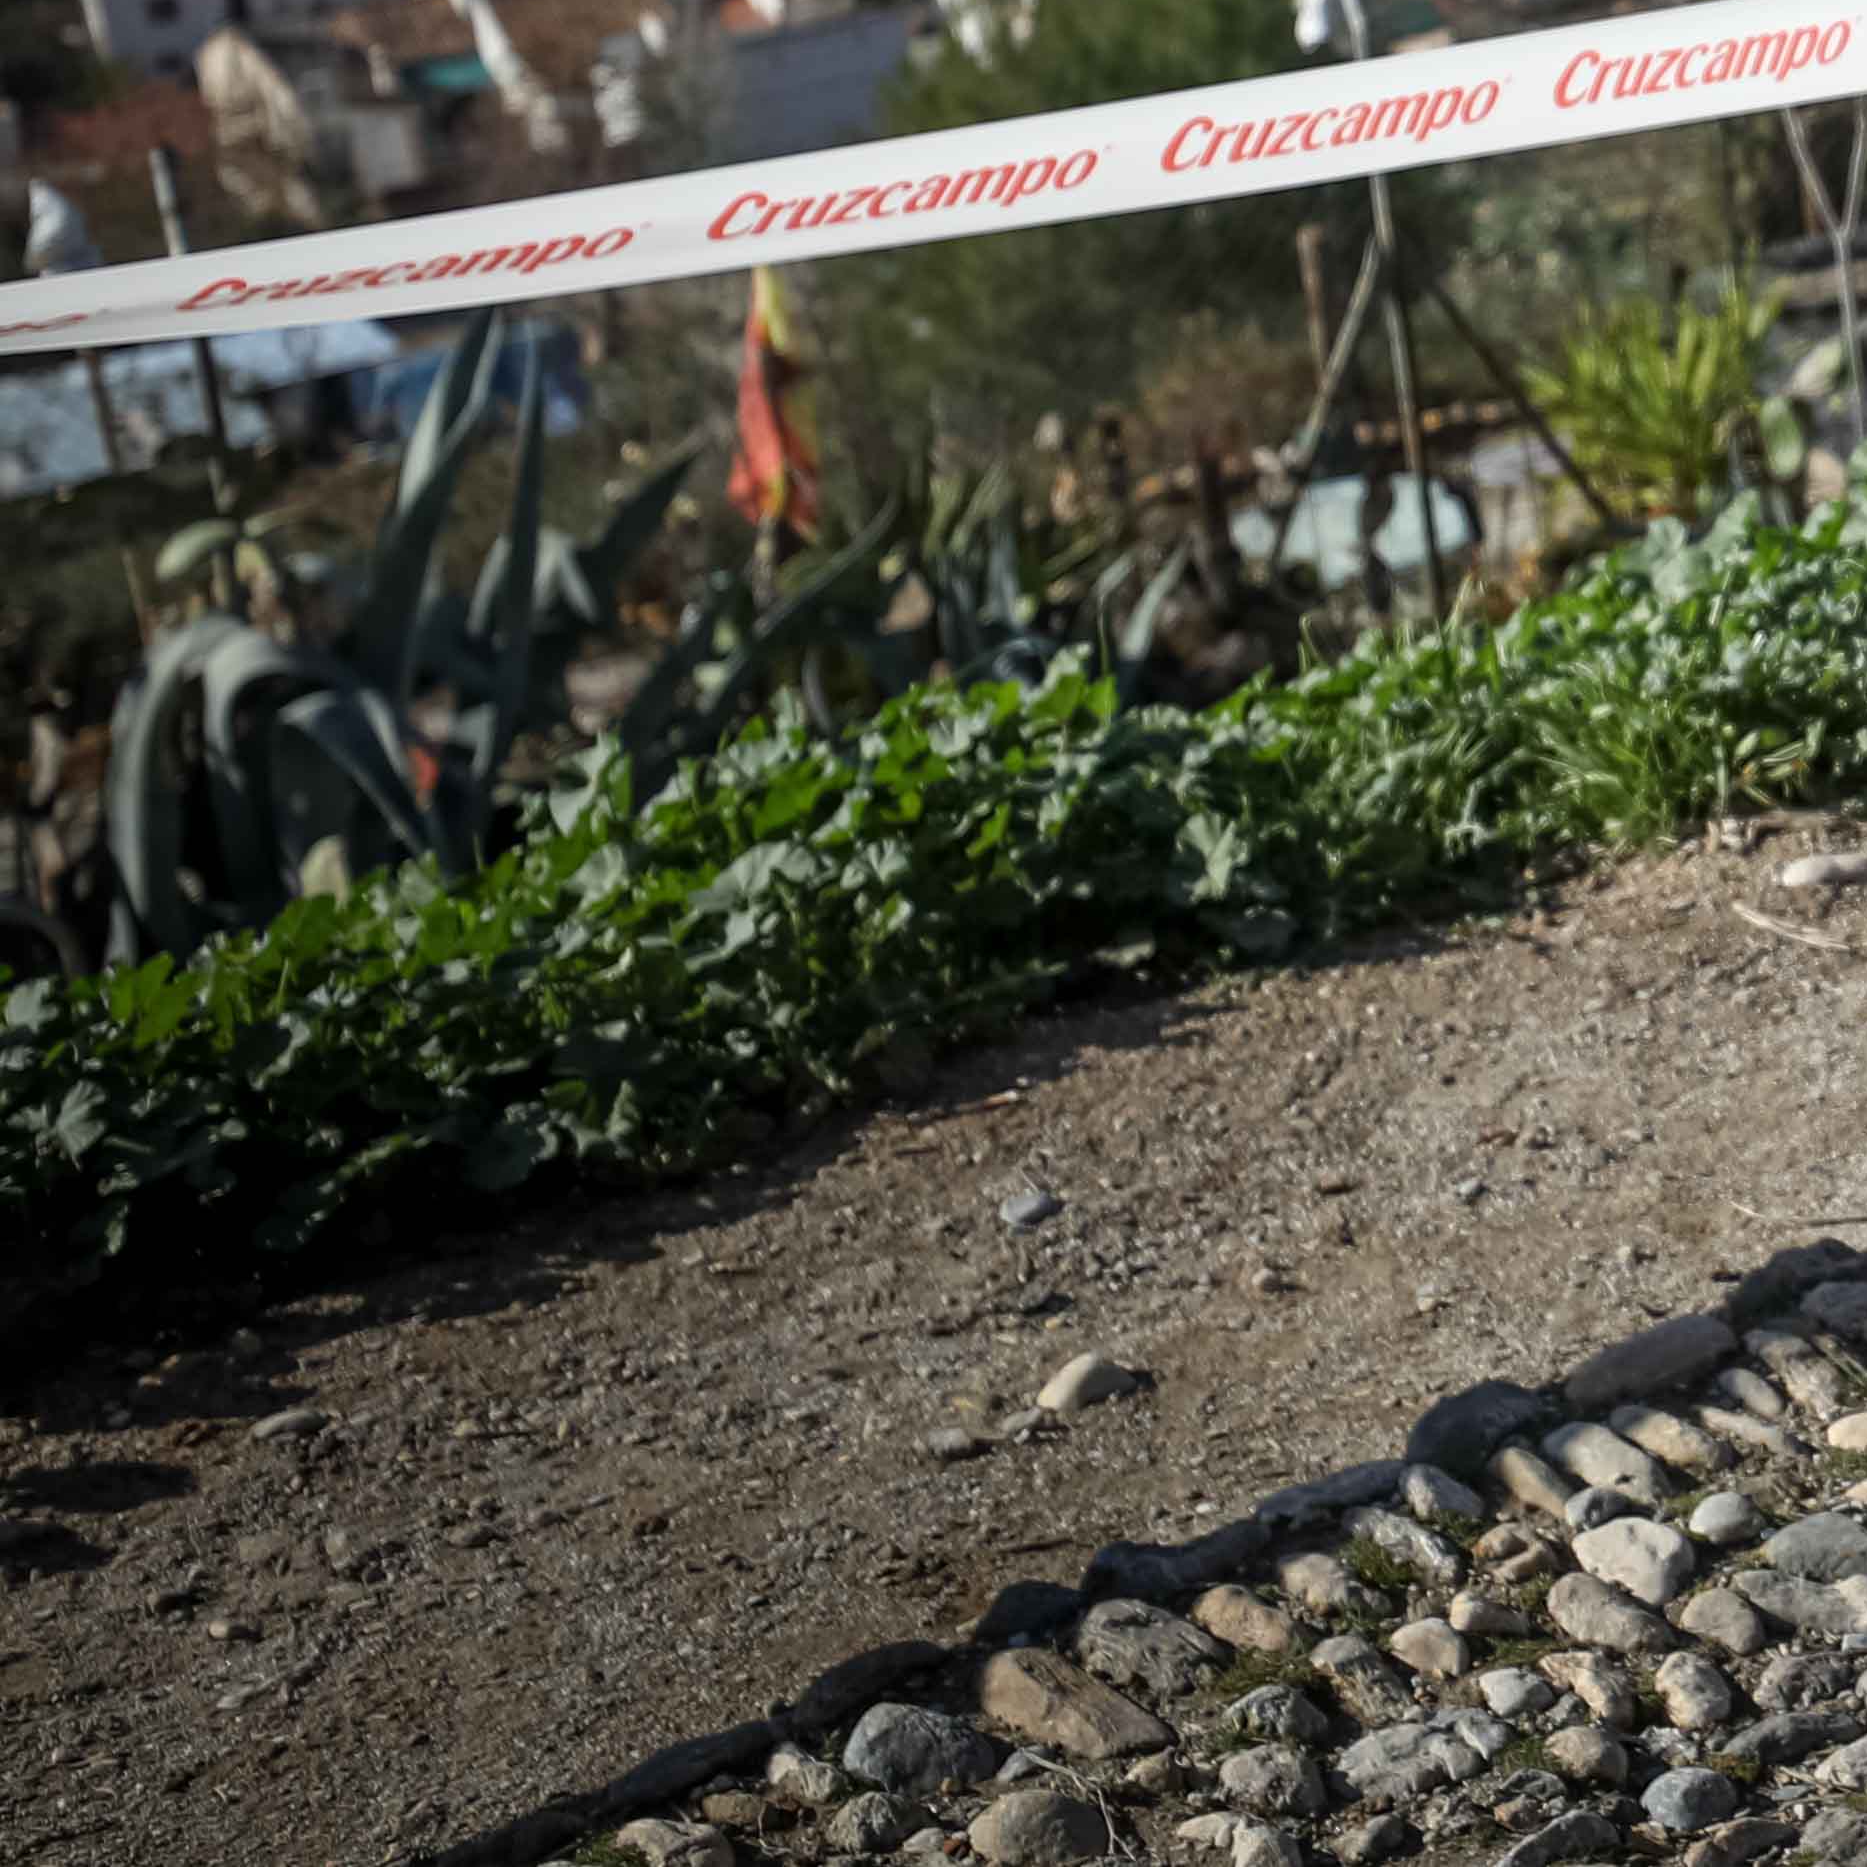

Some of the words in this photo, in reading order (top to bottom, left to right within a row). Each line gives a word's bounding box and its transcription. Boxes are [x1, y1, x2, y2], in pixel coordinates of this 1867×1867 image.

[176, 225, 635, 312] Cruzcampo
[706, 147, 1099, 241] Cruzcampo
[1160, 79, 1501, 173] Cruzcampo
[1552, 18, 1852, 110] Cruzcampo
